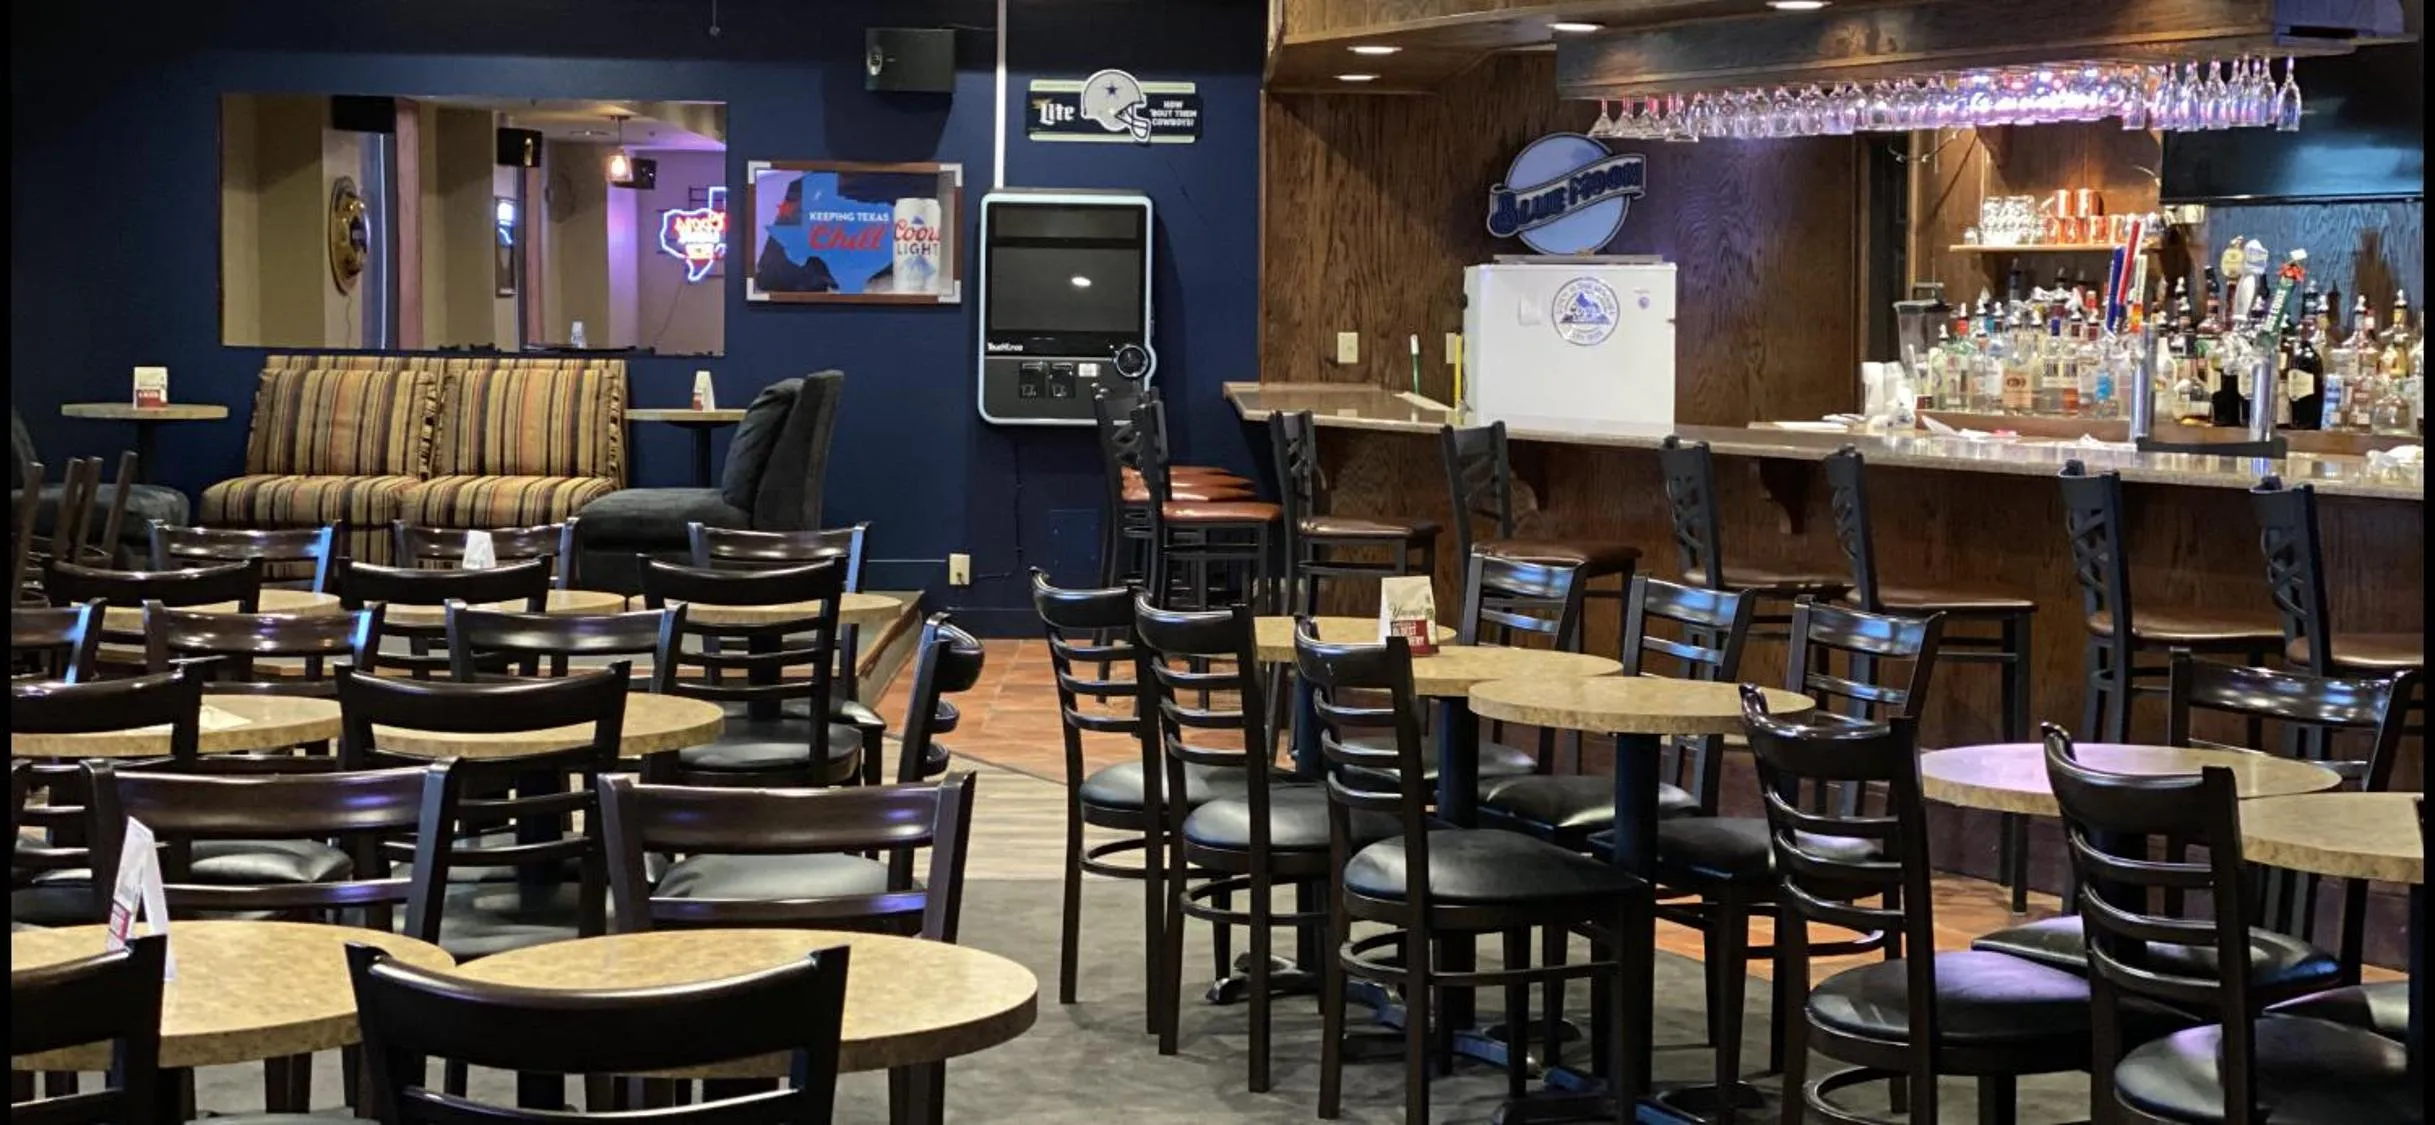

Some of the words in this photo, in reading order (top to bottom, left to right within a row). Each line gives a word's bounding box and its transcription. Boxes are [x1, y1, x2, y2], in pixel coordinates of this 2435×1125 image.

[1039, 101, 1076, 126] Lite
[1490, 187, 1567, 236] BLUE
[1569, 162, 1643, 206] MOON
[809, 211, 855, 222] KEEPING
[857, 211, 889, 222] TEXAS
[808, 222, 888, 250] Chill
[896, 243, 939, 256] LIGHT
